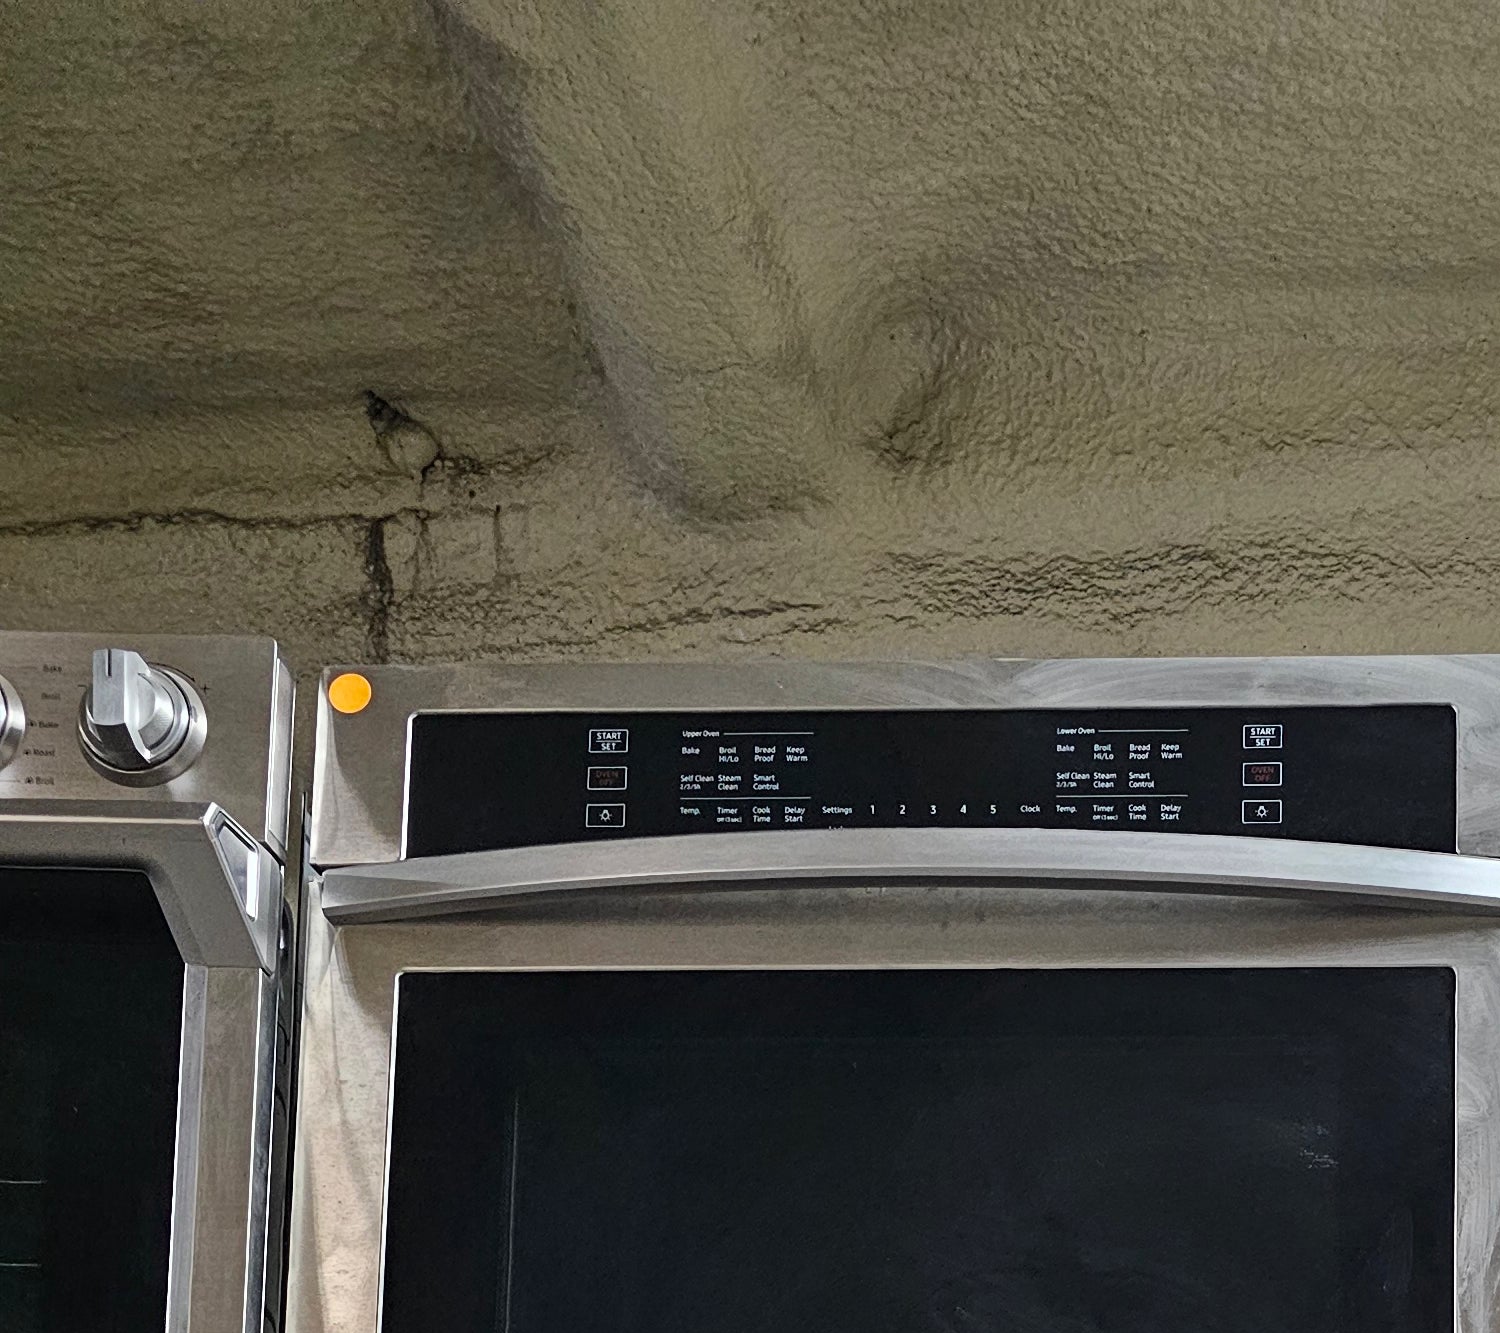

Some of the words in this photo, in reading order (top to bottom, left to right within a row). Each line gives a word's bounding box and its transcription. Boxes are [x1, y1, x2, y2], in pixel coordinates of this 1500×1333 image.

[682, 730, 702, 738] Upper
[1056, 727, 1077, 735] Lower
[1250, 727, 1276, 736] START
[597, 732, 622, 740] START
[601, 743, 617, 751] SET
[1255, 739, 1271, 747] SET
[754, 746, 776, 754] Bread
[786, 746, 805, 755] Keep
[1056, 744, 1075, 752] Bake
[1093, 744, 1112, 752] Broil
[1161, 743, 1180, 752] Keep
[1129, 752, 1149, 760] Proof
[1251, 766, 1274, 774] OVEN
[753, 774, 775, 782] Smart
[1056, 772, 1071, 780] Self
[1071, 772, 1090, 780] Clean
[1254, 774, 1270, 782] OFF
[718, 783, 739, 791] Clean
[1129, 780, 1155, 788] Control
[752, 806, 771, 814] Cook
[784, 806, 806, 815] Delay
[822, 805, 853, 815] Settings
[870, 805, 875, 815] 1
[899, 805, 906, 815] 2
[930, 805, 937, 815] 3
[959, 805, 967, 815] 4
[990, 805, 997, 815] 5
[1020, 804, 1041, 814] Clock
[1056, 805, 1077, 813] Temp.
[1128, 804, 1147, 812] Cook
[1160, 804, 1182, 812] Delay
[752, 815, 771, 823] Time
[784, 815, 803, 823] Start
